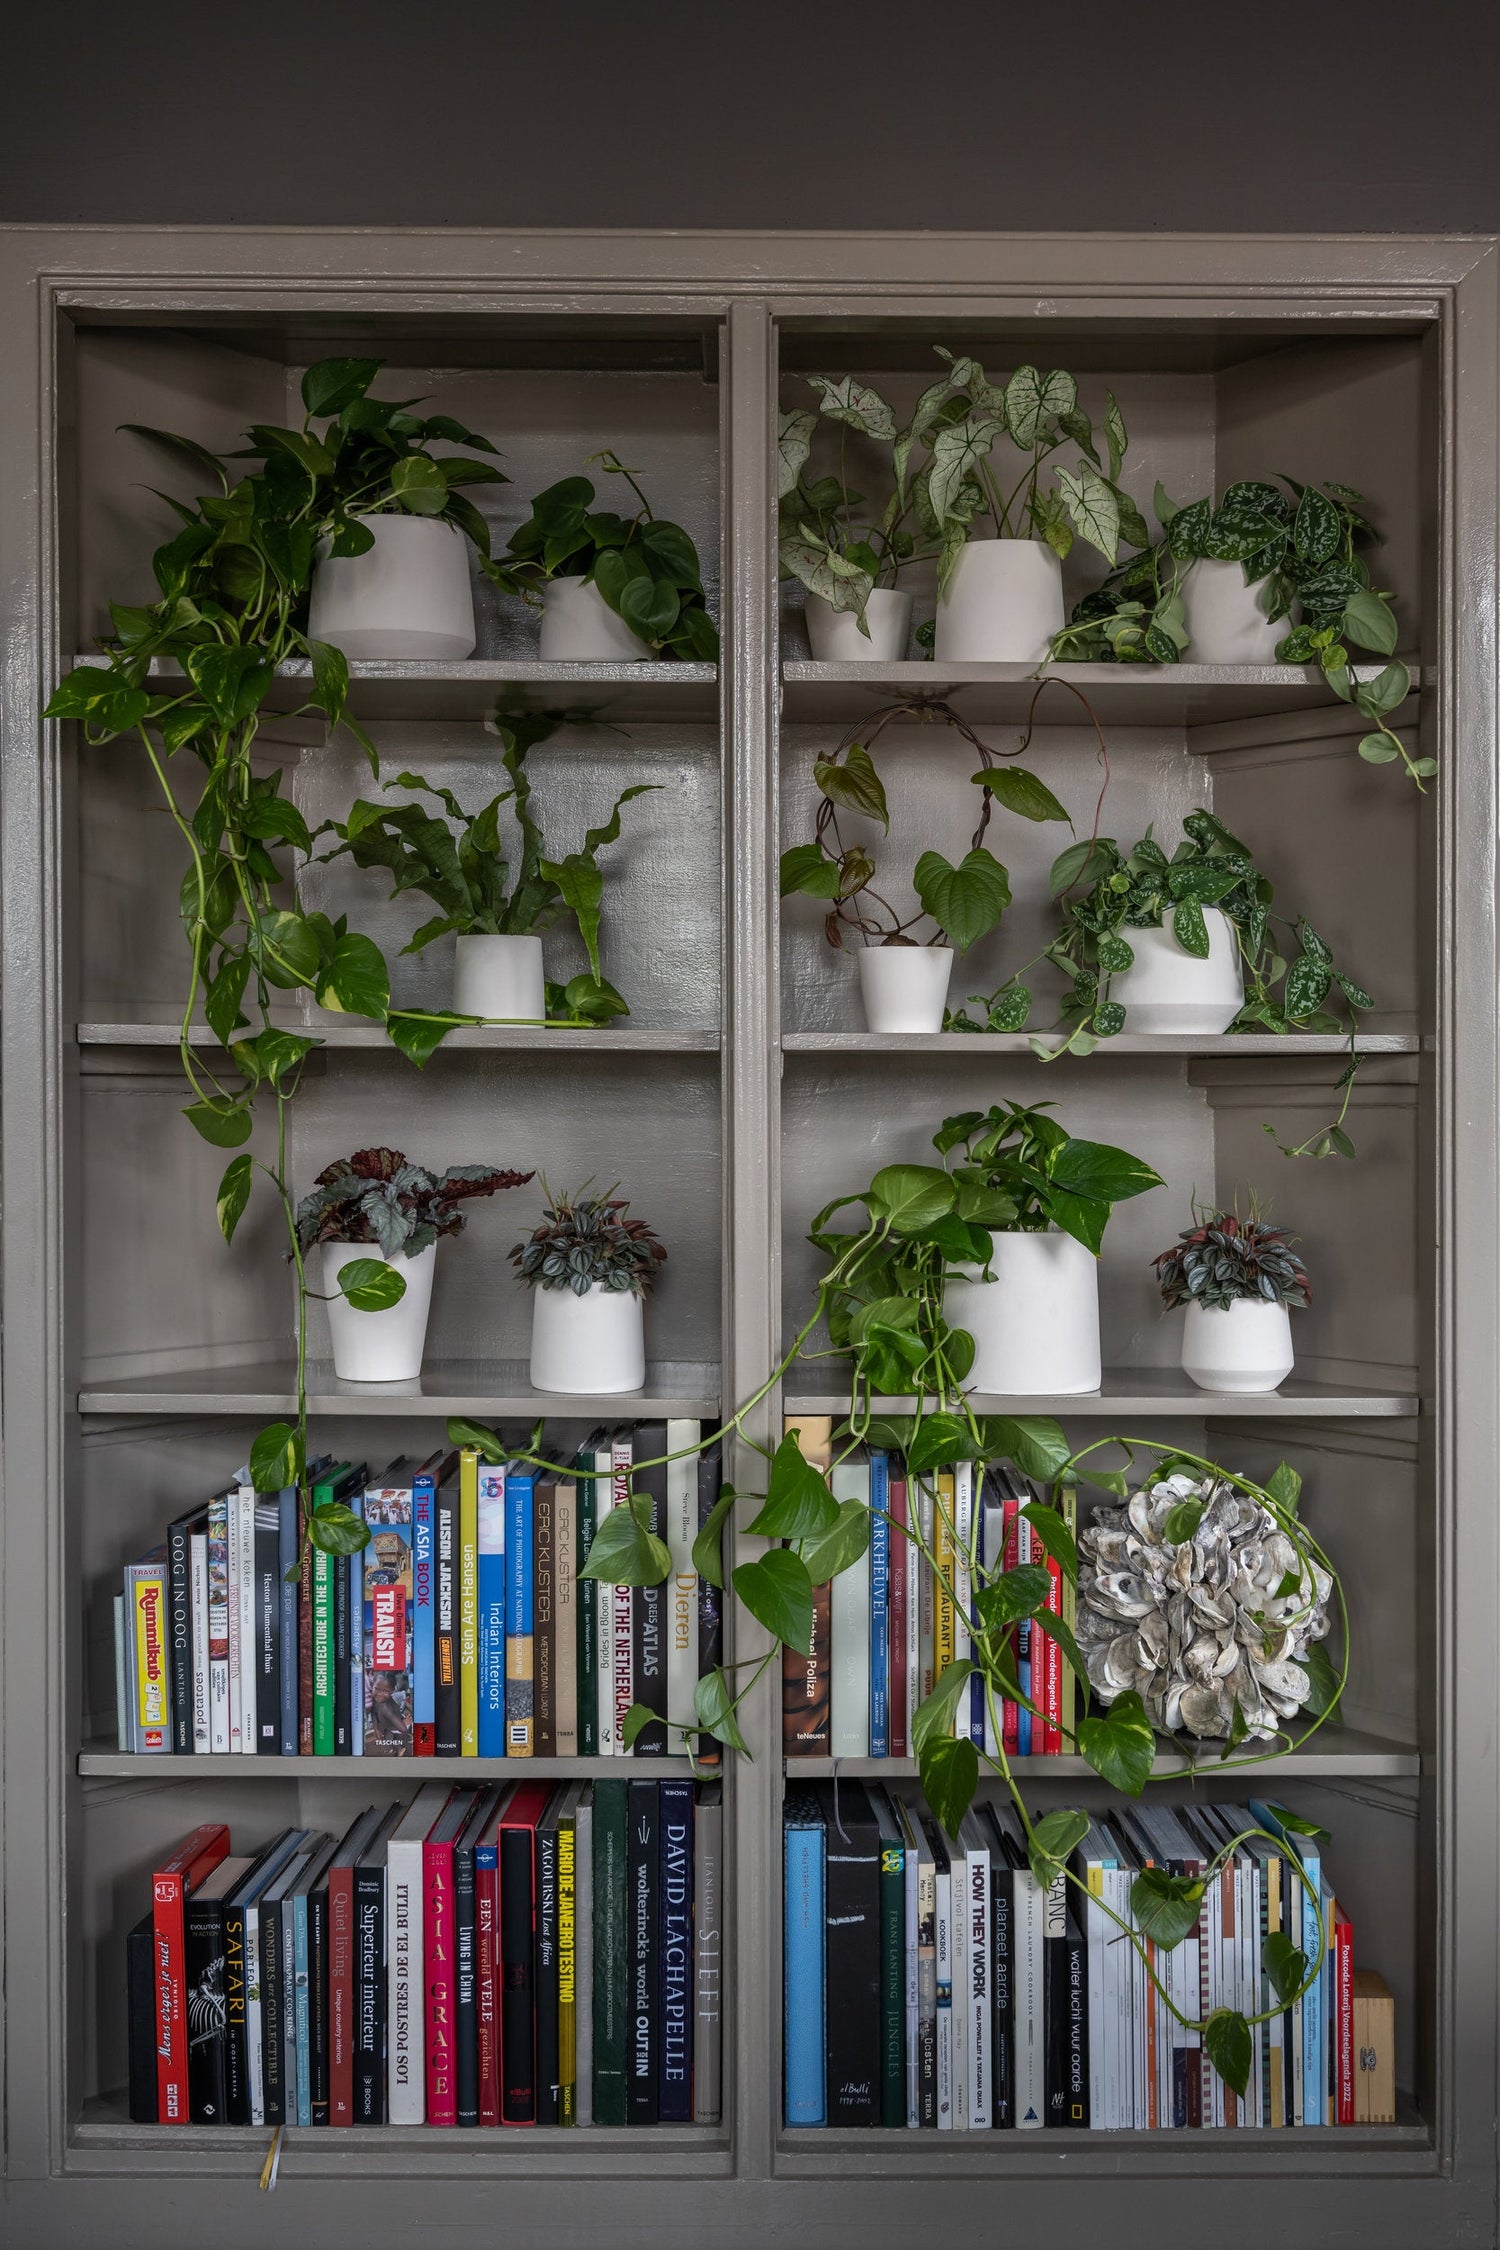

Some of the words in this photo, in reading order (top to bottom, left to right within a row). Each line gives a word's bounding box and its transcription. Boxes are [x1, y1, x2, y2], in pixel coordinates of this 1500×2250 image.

[243, 1496, 251, 1513] het
[417, 1493, 429, 1522] THE
[515, 1500, 524, 1513] THE
[515, 1514, 524, 1527] ART
[682, 1492, 690, 1515] Steve
[243, 1520, 251, 1553] nieuwe
[417, 1523, 430, 1561] ASIA
[440, 1508, 452, 1560] ALISON
[515, 1528, 524, 1538] OF
[538, 1503, 551, 1544] ERIC
[558, 1507, 570, 1541] ERIC
[582, 1518, 593, 1542] België
[682, 1516, 690, 1542] Bloom
[132, 1569, 164, 1577] TRAVEL
[173, 1535, 185, 1575] OOG
[243, 1559, 251, 1588] koken
[461, 1544, 475, 1597] Hansen
[515, 1539, 524, 1587] PHOTOGRAPHY
[558, 1543, 570, 1605] KUSTER
[173, 1583, 185, 1602] IN
[263, 1573, 273, 1603] Heston
[302, 1556, 311, 1602] GEVOGELTE
[316, 1585, 327, 1605] THE
[418, 1562, 430, 1608] BOOK
[440, 1562, 453, 1631] JACKSON
[515, 1589, 524, 1598] AT
[538, 1547, 551, 1623] KUSTER
[583, 1580, 593, 1604] Tuinen
[615, 1585, 630, 1603] OF
[892, 1567, 904, 1614] Kaas&wijn
[229, 1584, 240, 1618] VERFIJNDE
[284, 1598, 293, 1615] pan
[315, 1606, 327, 1618] IN
[461, 1600, 474, 1626] Are
[515, 1599, 524, 1633] NATIONAL
[600, 1596, 610, 1626] Bloom
[675, 1572, 697, 1651] Dieren
[923, 1596, 932, 1608] De
[140, 1587, 161, 1681] Rummikub
[174, 1609, 187, 1649] OOG
[264, 1604, 274, 1652] Blumenthal
[338, 1612, 346, 1633] ITALIAN
[352, 1605, 361, 1649] Asperges
[376, 1590, 395, 1667] TRANSIT
[396, 1612, 404, 1639] Ommer
[490, 1602, 503, 1646] Indian
[600, 1628, 610, 1638] in
[615, 1606, 631, 1635] THE
[921, 1610, 932, 1636] Librije
[230, 1619, 240, 1680] VOORGERECHTEN
[265, 1653, 274, 1674] thuis
[315, 1620, 327, 1697] ARCHITECTURE
[338, 1634, 346, 1659] COOKERY
[441, 1639, 452, 1683] CONFIDENTIAL
[460, 1629, 474, 1665] Stein
[515, 1633, 524, 1676] GEOGRAPHIC
[540, 1635, 549, 1692] METROPOLITAN
[599, 1639, 610, 1669] Brides
[490, 1651, 503, 1711] Interiors
[806, 1660, 817, 1698] Poliza
[1047, 1643, 1057, 1711] Voordeelagenda
[195, 1671, 208, 1725] potatoes
[540, 1693, 549, 1720] LUXURY
[375, 1738, 404, 1746] TASCHEN
[558, 1830, 575, 1872] MARIO
[666, 1824, 686, 1904] DAVID
[542, 1839, 554, 1914] ZAGOURSKI
[558, 1872, 575, 1892] DE
[704, 1855, 715, 1923] JEANLOUP
[972, 1864, 985, 1903] HOW
[315, 1904, 321, 1913] ON
[332, 1892, 348, 1930] Quiet
[396, 1884, 409, 1928] BULLI
[480, 1898, 492, 1932] EEN
[636, 1863, 651, 1960] wolterinck's
[954, 1878, 964, 1917] Stijlvol
[190, 1923, 221, 1931] EVOLUTION
[432, 1872, 447, 1962] ASIA
[542, 1916, 553, 1936] Lost
[558, 1893, 575, 1949] JANEIRO
[890, 1910, 898, 1945] FRANS
[972, 1904, 985, 1948] THEY
[994, 1897, 1009, 1958] planeet
[265, 1917, 276, 1981] WONDERS
[331, 1936, 348, 1977] living
[359, 1904, 379, 1981] Superieur
[396, 1933, 409, 1953] EL
[459, 1925, 473, 1958] LIVING
[480, 1937, 492, 1975] wereld
[539, 1937, 553, 1966] Africa
[939, 1919, 947, 1963] KOOKBOEK
[954, 1922, 964, 1957] tafelen
[226, 1921, 246, 2024] SAFARI
[284, 1928, 293, 1996] CONTEMPORARY
[396, 1956, 409, 1978] DE
[460, 1961, 472, 1971] IN
[558, 1949, 575, 2003] TESTINO
[698, 1929, 720, 2023] SIEFF
[889, 1948, 898, 1999] LANTING
[972, 1948, 985, 1999] WORK
[1071, 1949, 1083, 1988] water
[1341, 1944, 1351, 1983] Postcode
[158, 1985, 172, 2021] erger
[267, 1982, 275, 1997] are
[334, 1989, 343, 2012] Unique
[460, 1974, 474, 2004] CHINA
[481, 1978, 493, 2023] VELE
[636, 1963, 650, 2011] world
[665, 1914, 685, 2081] LACHAPELLE
[996, 1962, 1010, 2009] aarde
[1071, 1988, 1083, 2021] lucht
[1340, 1983, 1351, 2011] Loterij
[230, 2029, 237, 2039] IN
[285, 1997, 295, 2038] COOKING
[296, 1993, 308, 2044] Magnifico!
[334, 2013, 343, 2038] country
[363, 1984, 380, 2052] interieur
[396, 1983, 409, 2051] POSTRES
[266, 1998, 278, 2086] COLLECTIBLE
[335, 2038, 343, 2065] interiors
[431, 1981, 449, 2095] GRACE
[478, 2027, 492, 2079] gezichten
[886, 2010, 899, 2078] JUNGLES
[1071, 2023, 1083, 2051] vuur
[1341, 2011, 1351, 2080] Voordeelagenda
[396, 2055, 409, 2086] LOS
[924, 2037, 934, 2079] Oosten
[1071, 2052, 1084, 2093] aarde
[364, 2087, 372, 2116] BOOKS
[563, 2086, 571, 2115] TASCHEN
[924, 2092, 932, 2120] TERRA
[1341, 2081, 1351, 2102] 2022
